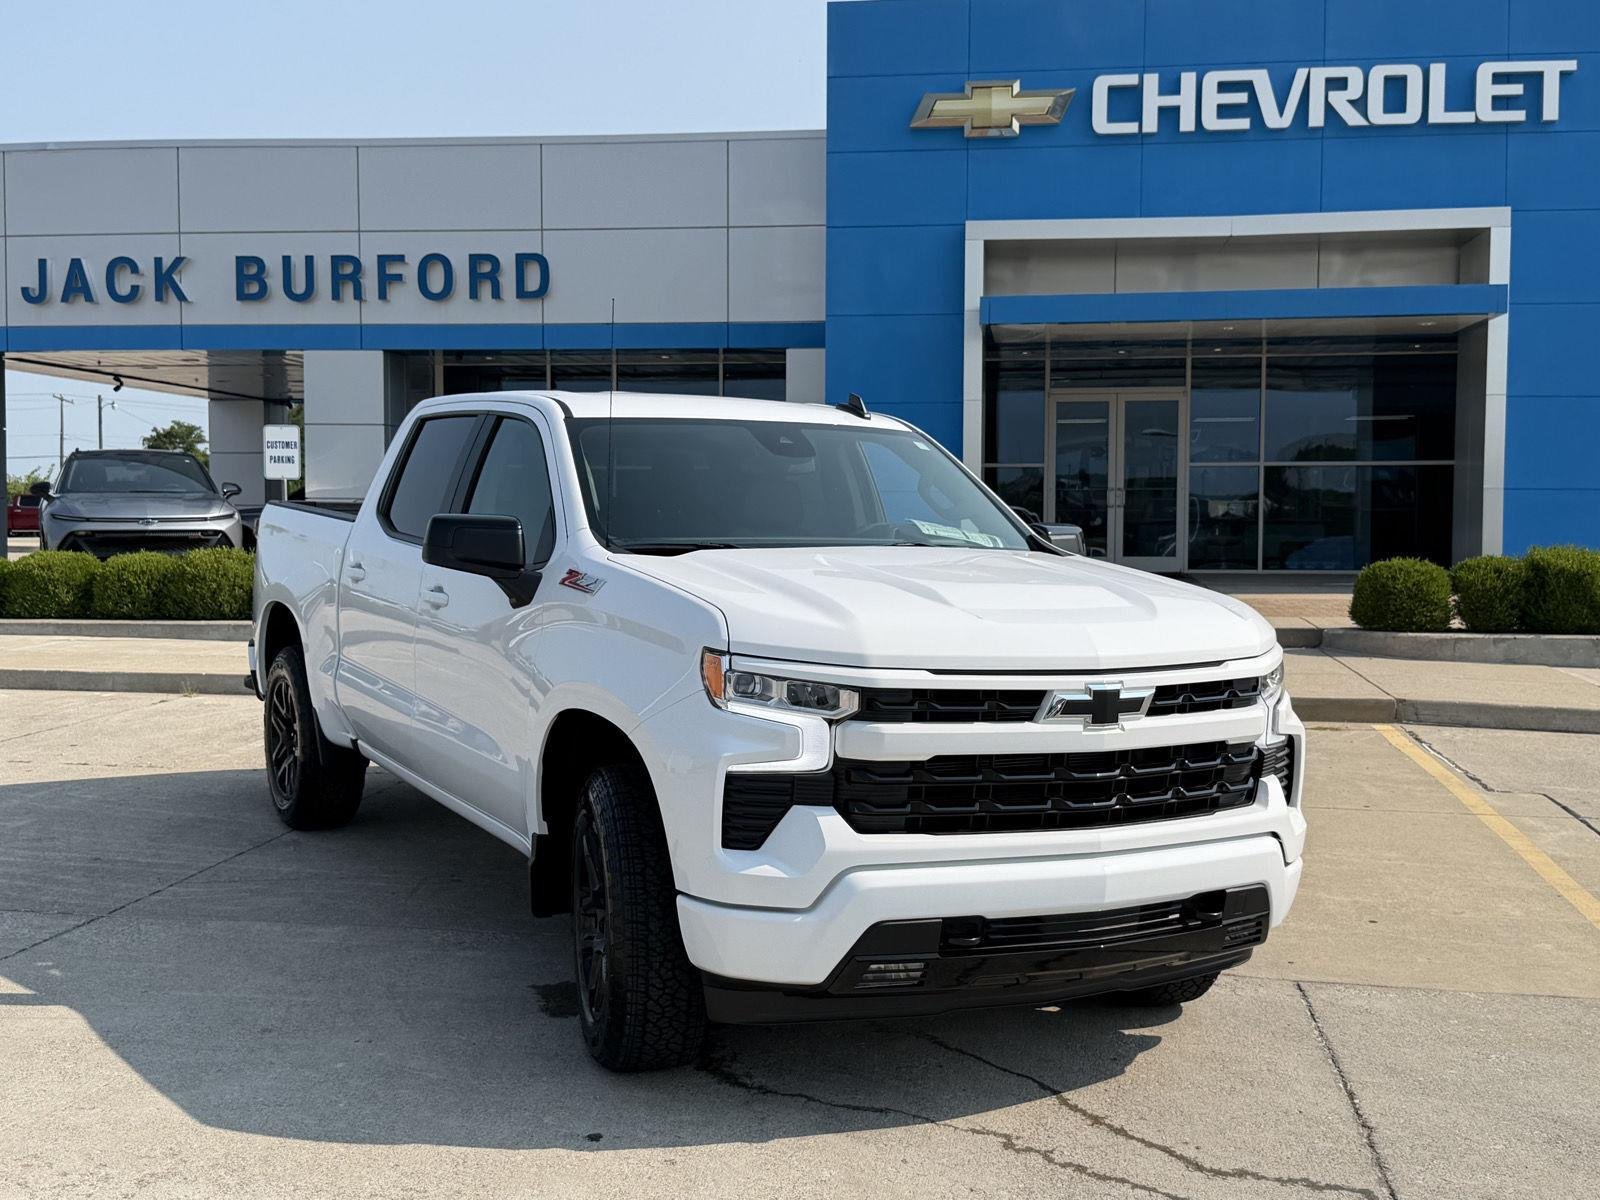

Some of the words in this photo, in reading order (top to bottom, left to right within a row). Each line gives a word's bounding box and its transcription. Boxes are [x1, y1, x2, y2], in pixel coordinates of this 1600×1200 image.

[1091, 60, 1578, 135] CHEVROLET
[20, 256, 192, 304] JACK
[235, 253, 551, 302] BURFORD
[266, 440, 298, 450] CUSTOMER
[269, 455, 296, 464] PARKING
